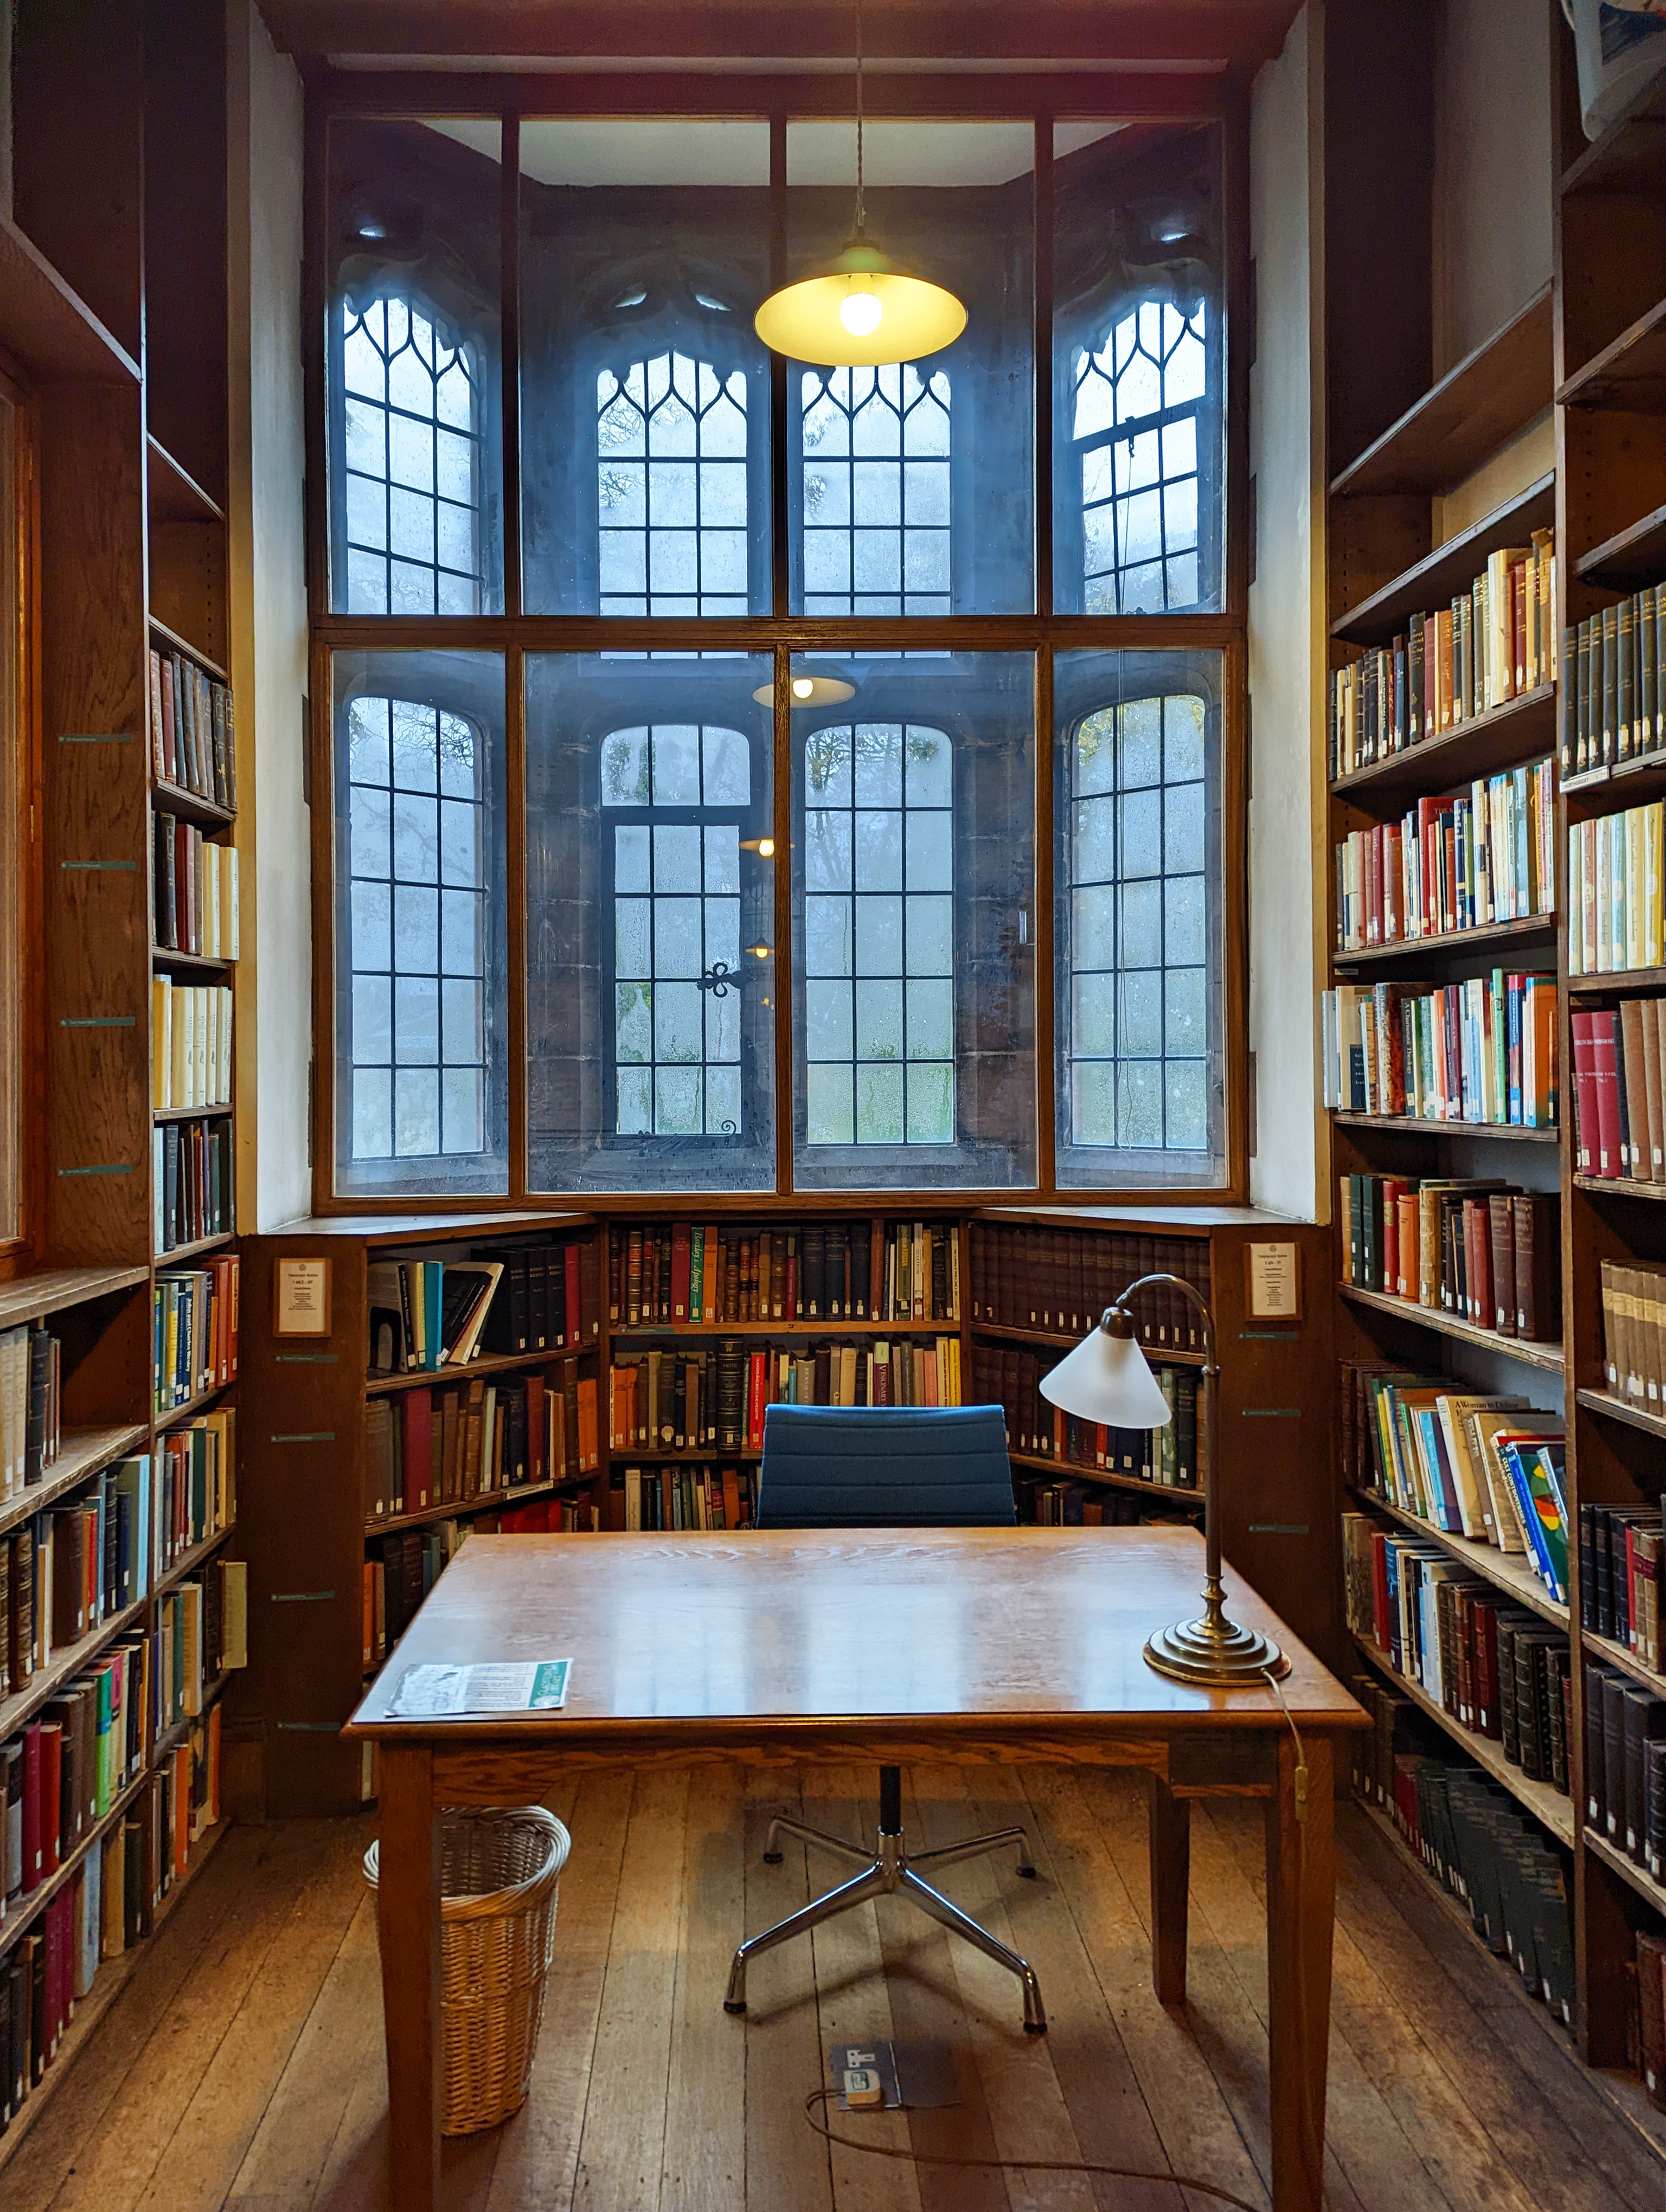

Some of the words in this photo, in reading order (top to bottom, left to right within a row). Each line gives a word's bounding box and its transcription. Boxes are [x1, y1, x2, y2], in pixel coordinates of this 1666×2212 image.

[692, 1232, 703, 1262] Barclay's
[690, 1265, 702, 1293] Apology
[1502, 1457, 1511, 1473] CULT
[1507, 1472, 1527, 1525] CONTROVERSIES
